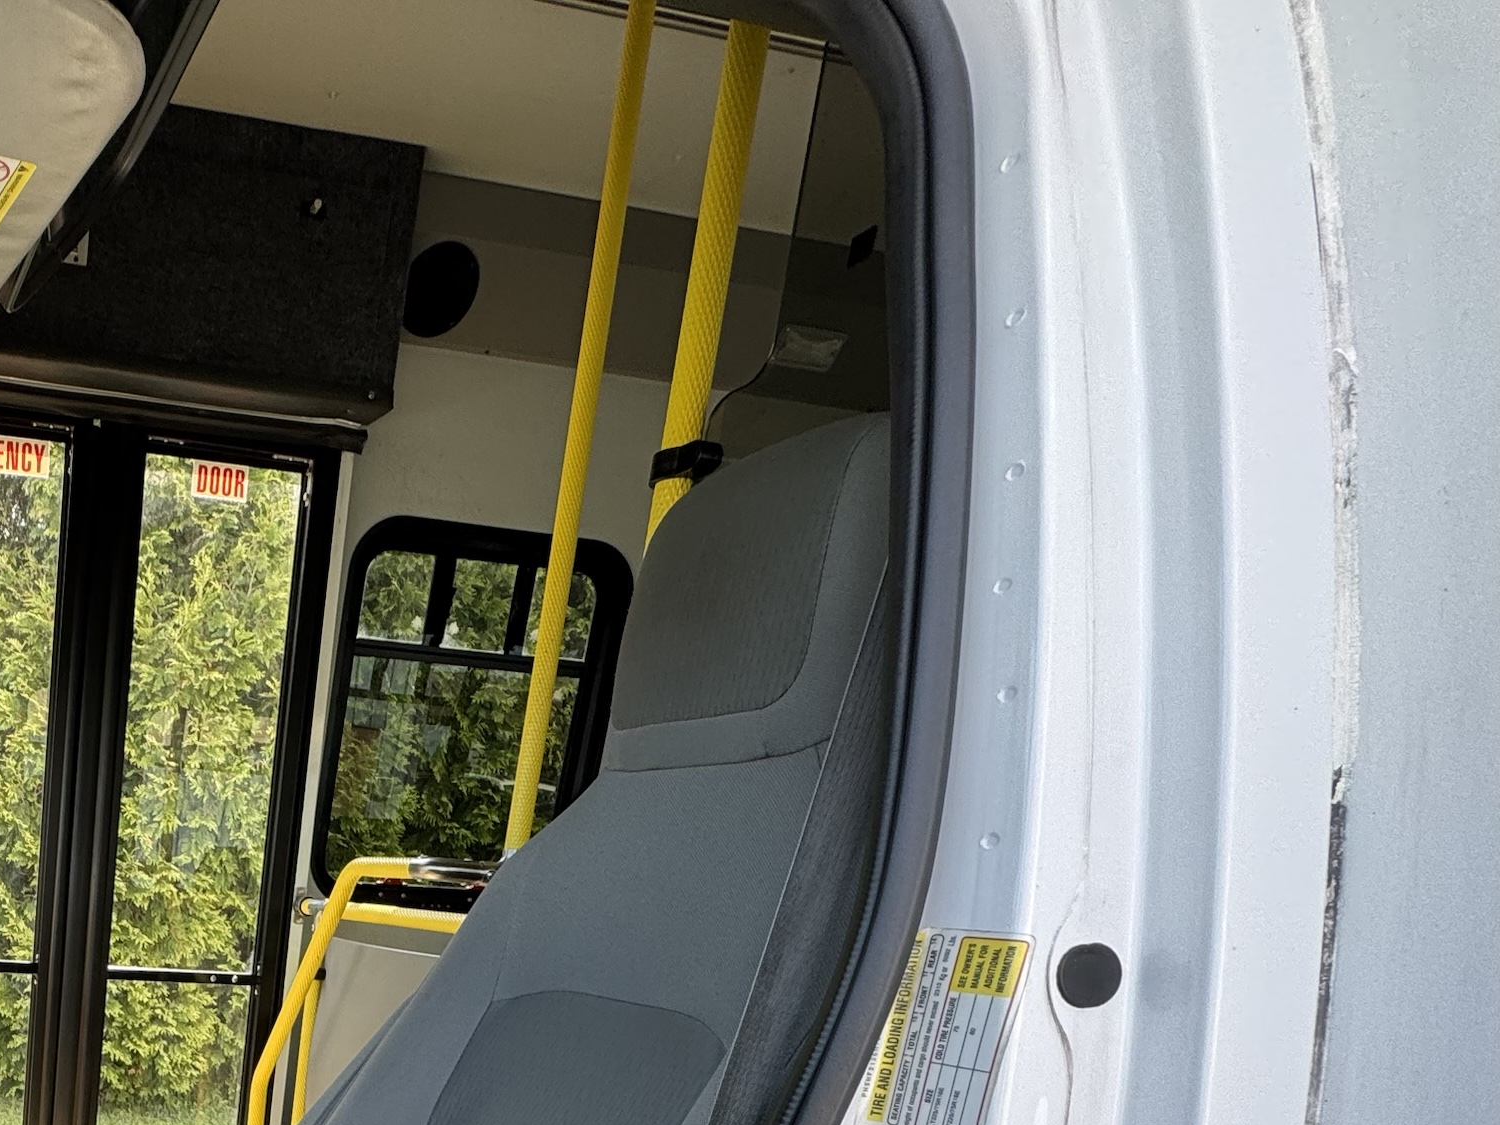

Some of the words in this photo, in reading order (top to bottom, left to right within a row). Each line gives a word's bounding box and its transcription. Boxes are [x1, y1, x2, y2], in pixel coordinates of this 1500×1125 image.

[197, 464, 245, 498] DOOR
[960, 943, 976, 974] OWNER'S
[970, 960, 985, 988] MANUAL
[978, 945, 989, 958] FOR
[983, 947, 1001, 988] ADDITIONAL
[995, 945, 1017, 992] INFORMATION
[957, 975, 967, 988] SEE
[942, 996, 957, 1028] PRESSURE
[881, 1017, 904, 1065] LOADING
[890, 1092, 902, 1120] SEATING
[897, 1059, 910, 1091] CAPACITY
[907, 1030, 917, 1050] TOTAL
[917, 985, 928, 1007] FRONT
[927, 949, 937, 967] REAR
[938, 1029, 948, 1042] TIRE
[934, 1044, 945, 1060] COLD
[875, 1067, 892, 1090] AND
[869, 1092, 886, 1117] TIRE
[923, 1088, 933, 1103] SIZE
